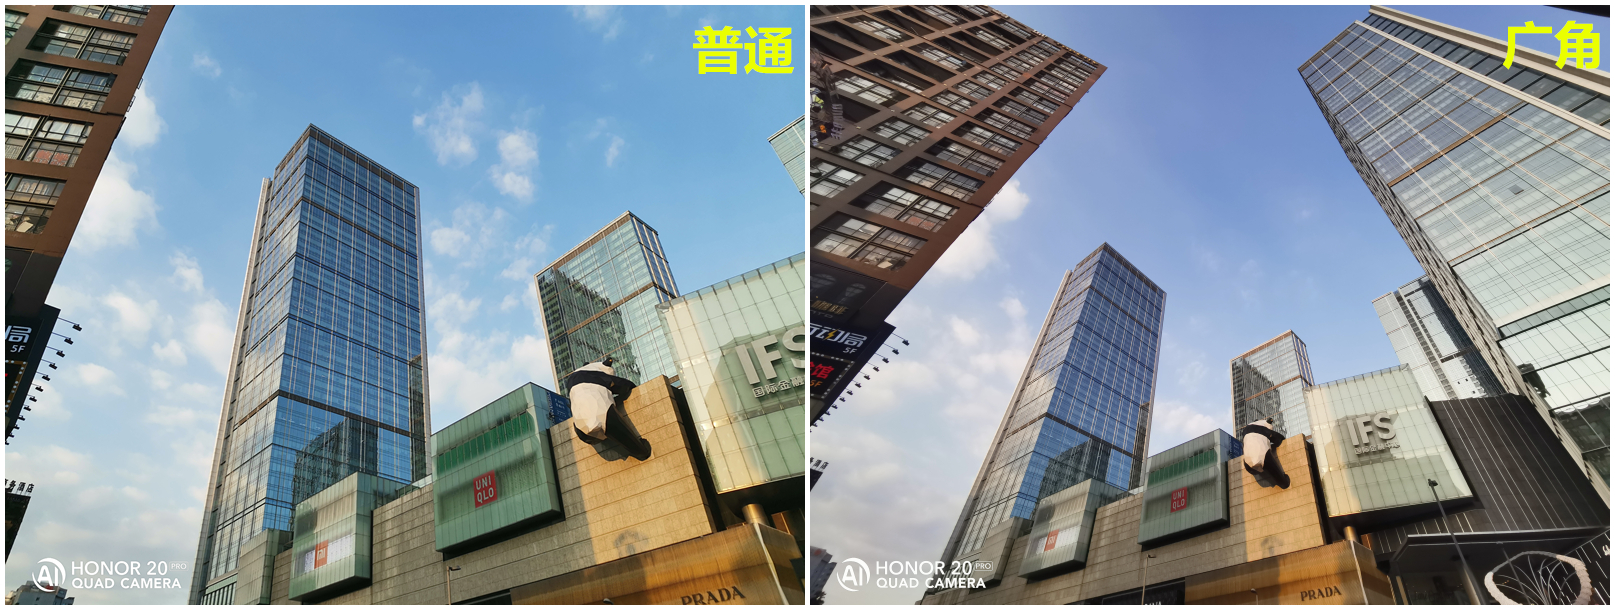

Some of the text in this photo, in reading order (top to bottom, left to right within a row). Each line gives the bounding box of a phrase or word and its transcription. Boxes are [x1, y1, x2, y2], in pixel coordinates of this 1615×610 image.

[810, 361, 835, 379] 馆
[1346, 412, 1396, 446] IFS
[475, 475, 492, 490] UNI
[476, 487, 494, 504] QLO
[1172, 489, 1185, 500] UNI
[680, 586, 746, 605] PRADA
[1300, 585, 1343, 602] PRADA
